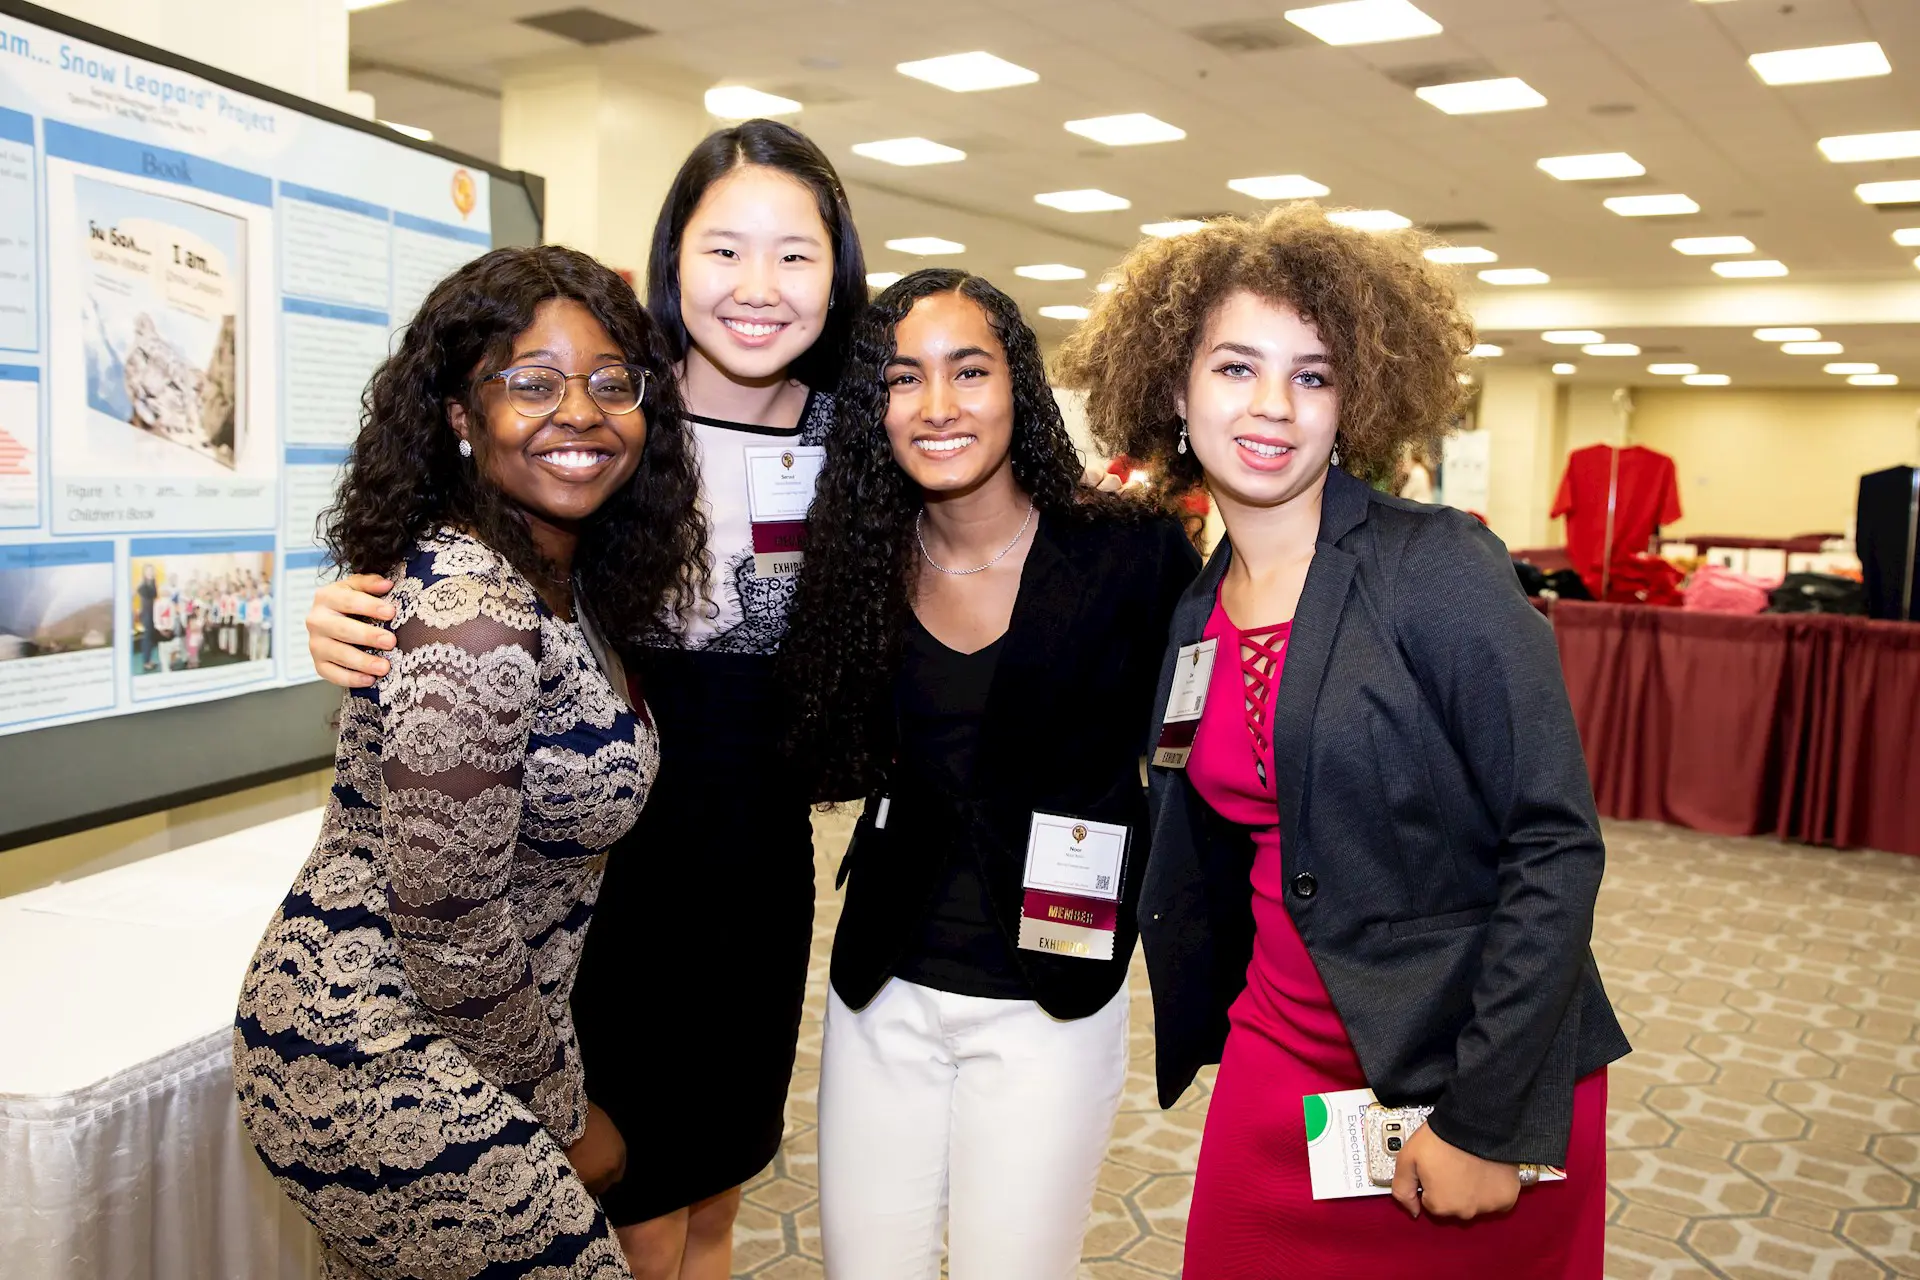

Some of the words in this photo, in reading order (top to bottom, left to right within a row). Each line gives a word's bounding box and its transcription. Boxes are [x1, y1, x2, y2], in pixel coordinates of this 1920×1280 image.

[60, 45, 116, 84] Snow
[217, 94, 276, 133] Project
[140, 151, 193, 182] Book
[1048, 904, 1093, 925] MEMBER
[1347, 1114, 1364, 1189] Expectations
